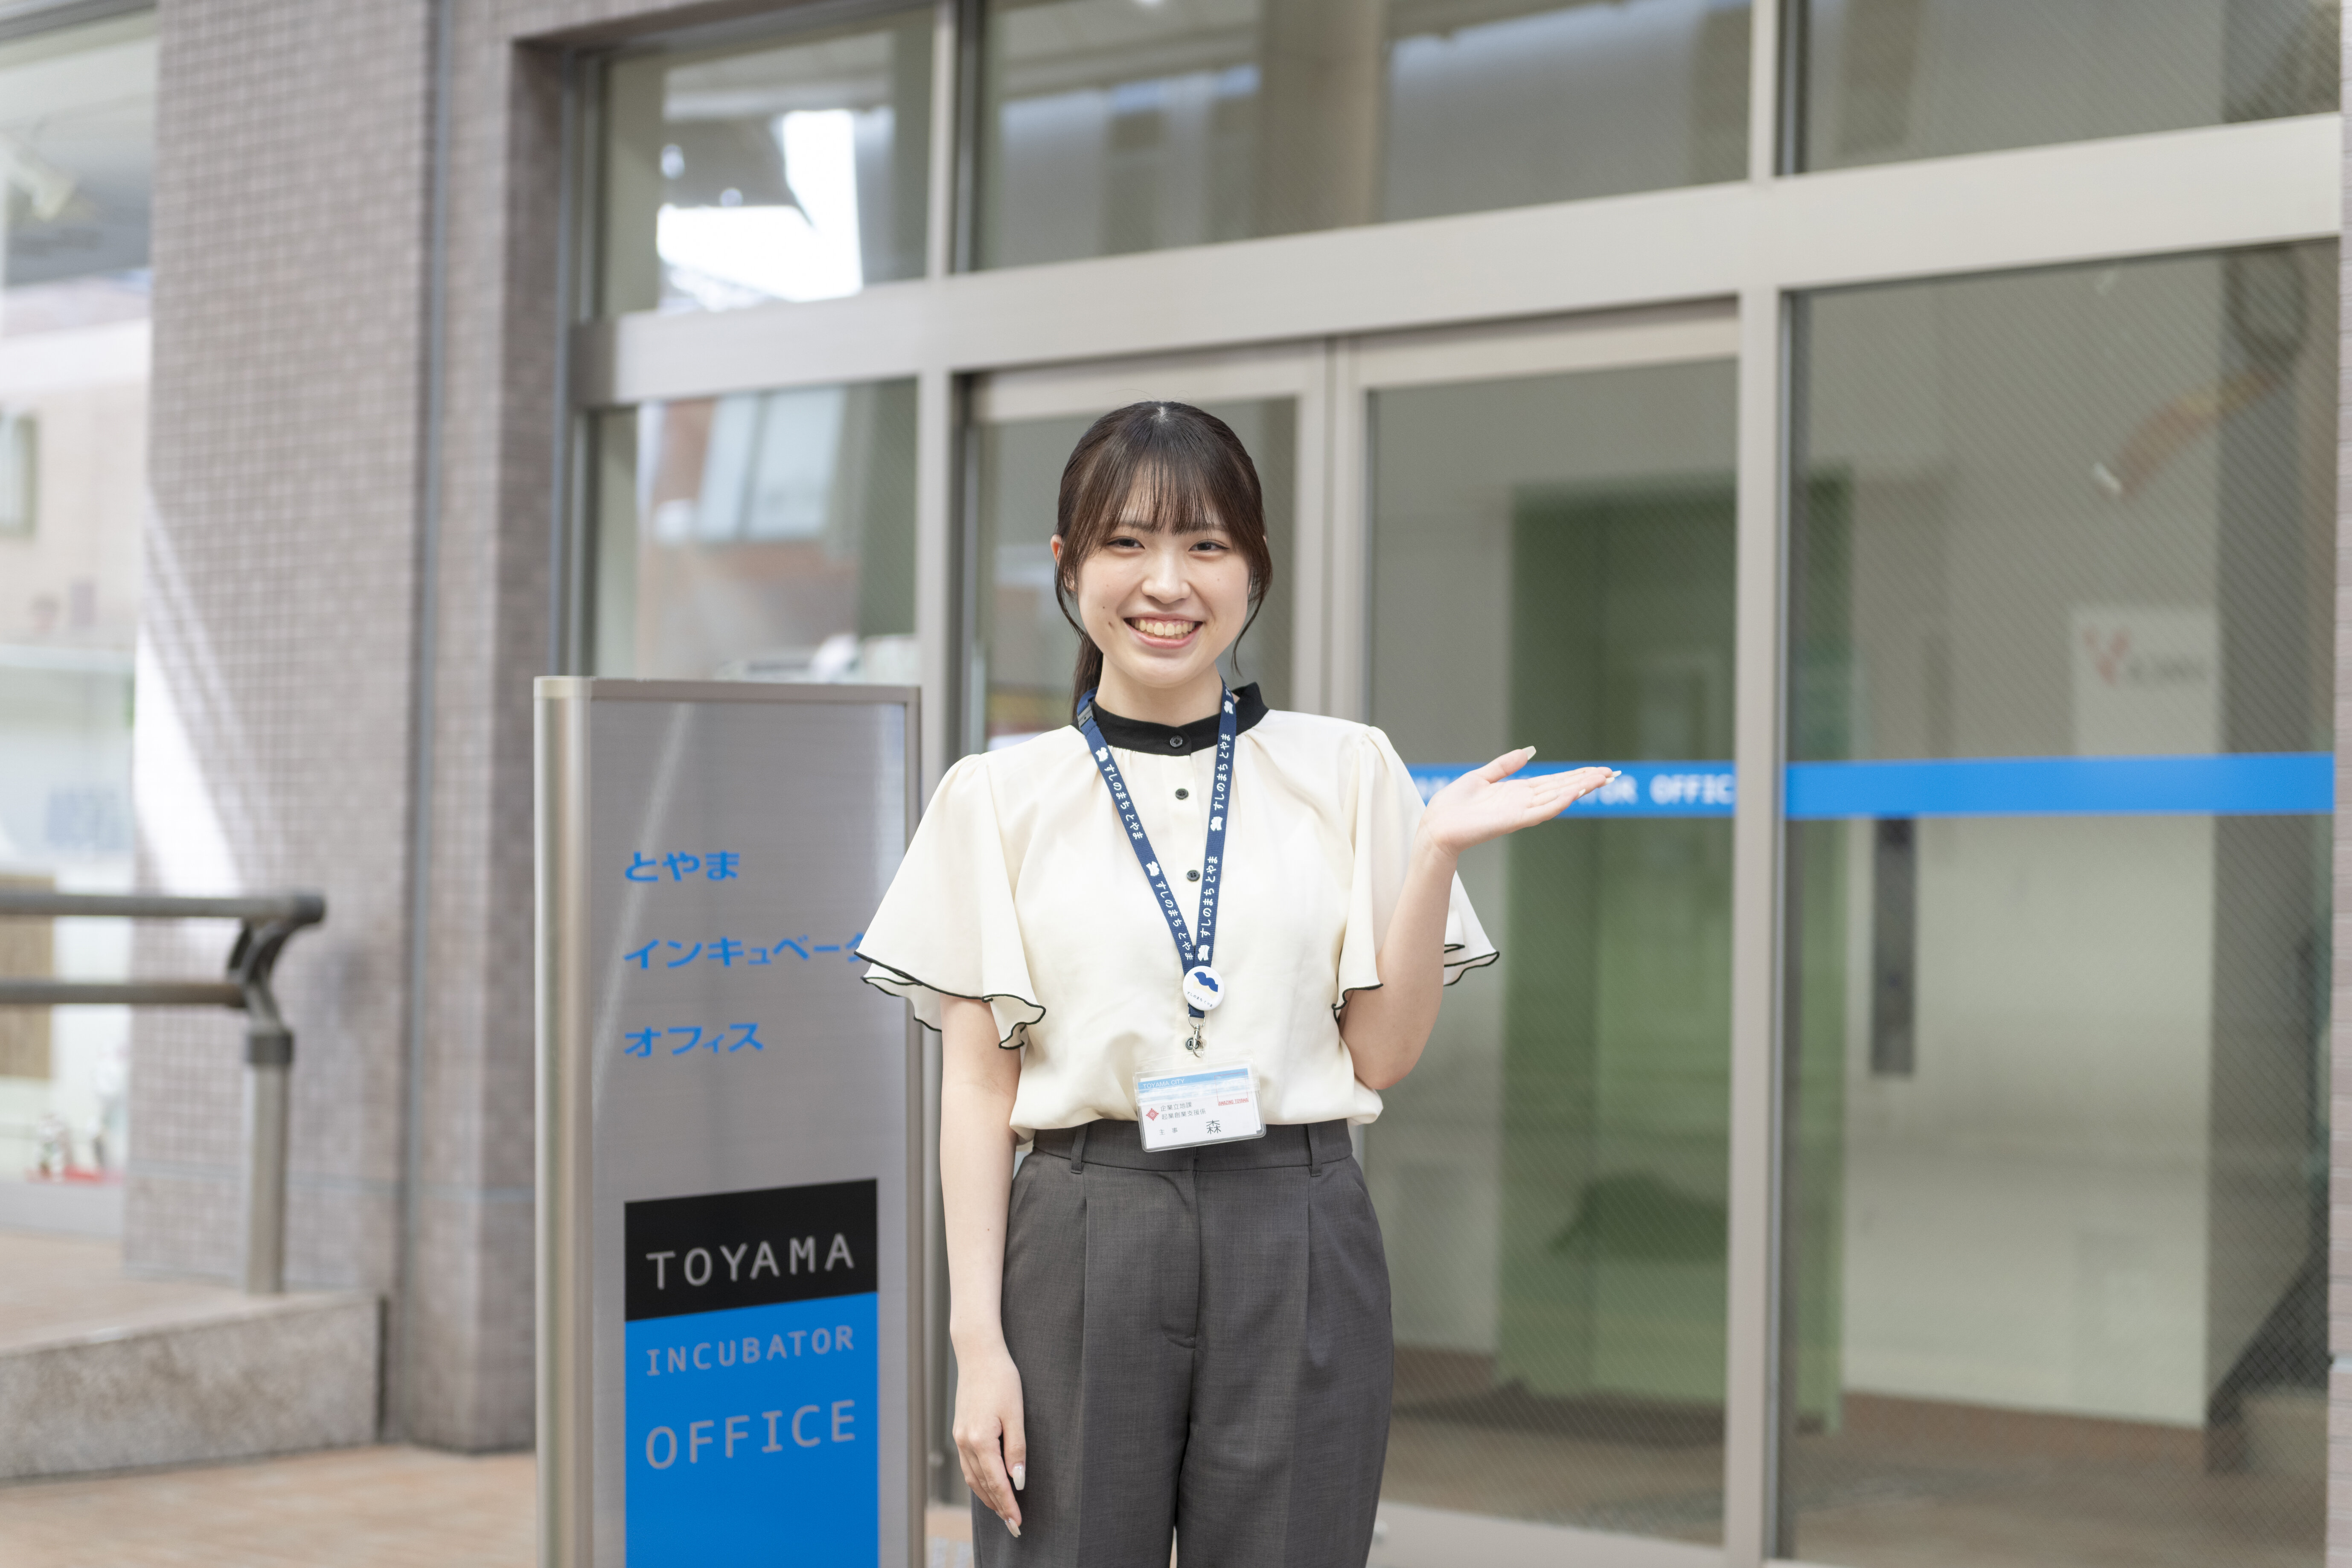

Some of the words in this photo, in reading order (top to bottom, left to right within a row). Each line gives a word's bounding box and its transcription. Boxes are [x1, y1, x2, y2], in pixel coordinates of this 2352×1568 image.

[1219, 733, 1231, 759] とやま
[1104, 764, 1130, 809] すしのまち
[1126, 814, 1143, 840] とやま
[1213, 764, 1228, 810] すしのまち
[624, 849, 740, 883] とやま
[1205, 856, 1218, 882] とやま
[1156, 881, 1182, 927] すしのまち
[1178, 932, 1193, 960] とやま
[1200, 888, 1215, 937] すしのまち
[1187, 991, 1203, 1002] すしのまち
[624, 1022, 764, 1058] オフィス
[1143, 1081, 1170, 1089] TOYAMA
[1170, 1078, 1185, 1086] CITY
[1160, 1102, 1192, 1111] 企業立地課
[1161, 1108, 1206, 1120] 起業創業支援係
[1206, 1120, 1221, 1135] 森
[646, 1233, 854, 1290] TOYAMA
[646, 1325, 854, 1376] INCUBATOR
[645, 1400, 856, 1470] OFFICE
